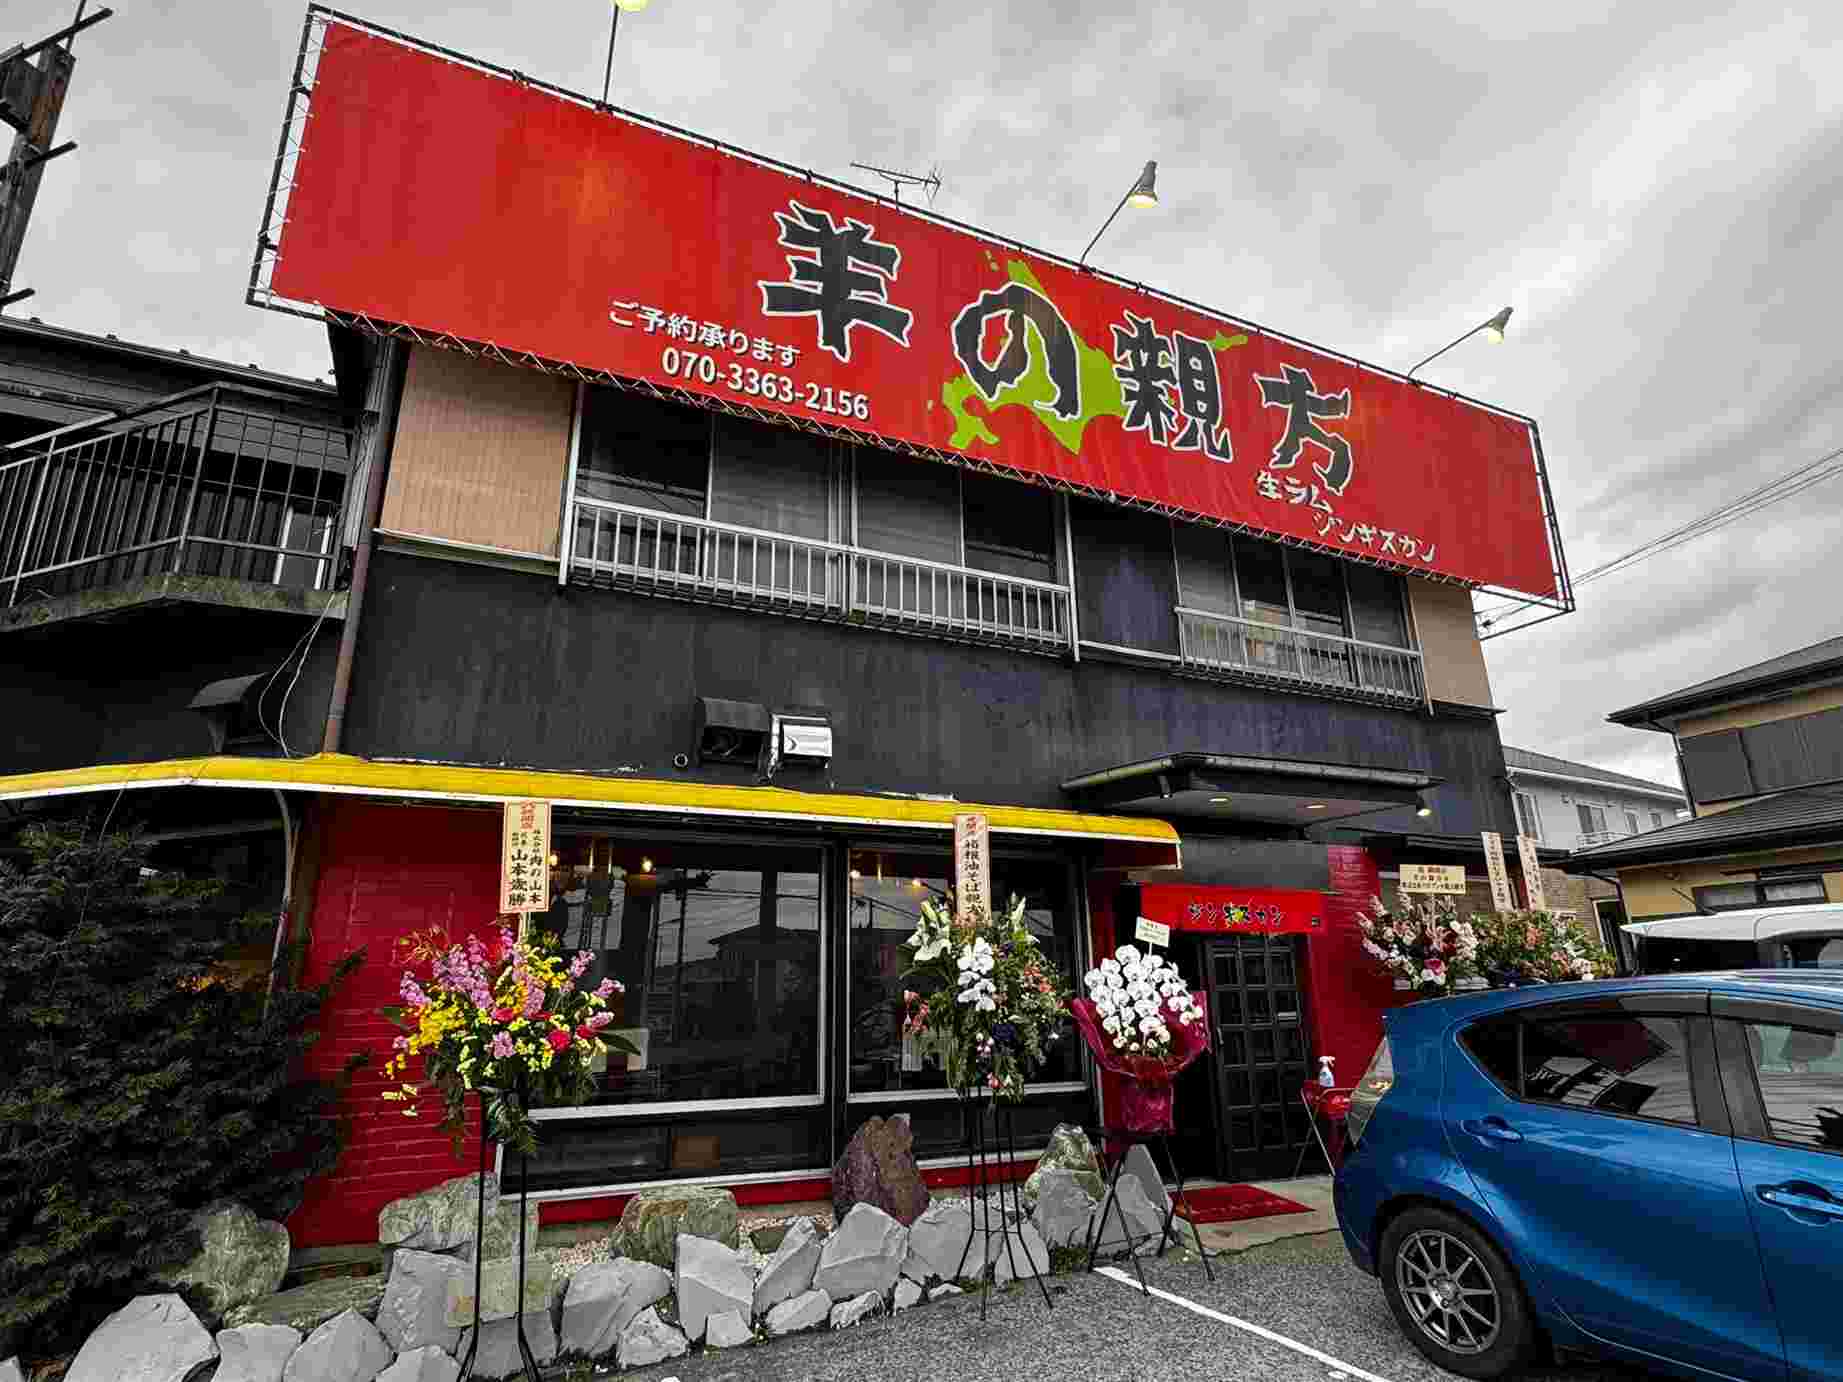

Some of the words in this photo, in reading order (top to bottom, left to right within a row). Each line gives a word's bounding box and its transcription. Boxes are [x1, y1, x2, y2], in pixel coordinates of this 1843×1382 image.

[608, 300, 801, 368] ご予約承ります
[758, 199, 1354, 496] 羊の親方
[662, 346, 870, 421] 070-3363-2156
[1255, 470, 1332, 513] 生ラム
[1312, 511, 1435, 561] ジンギスカン
